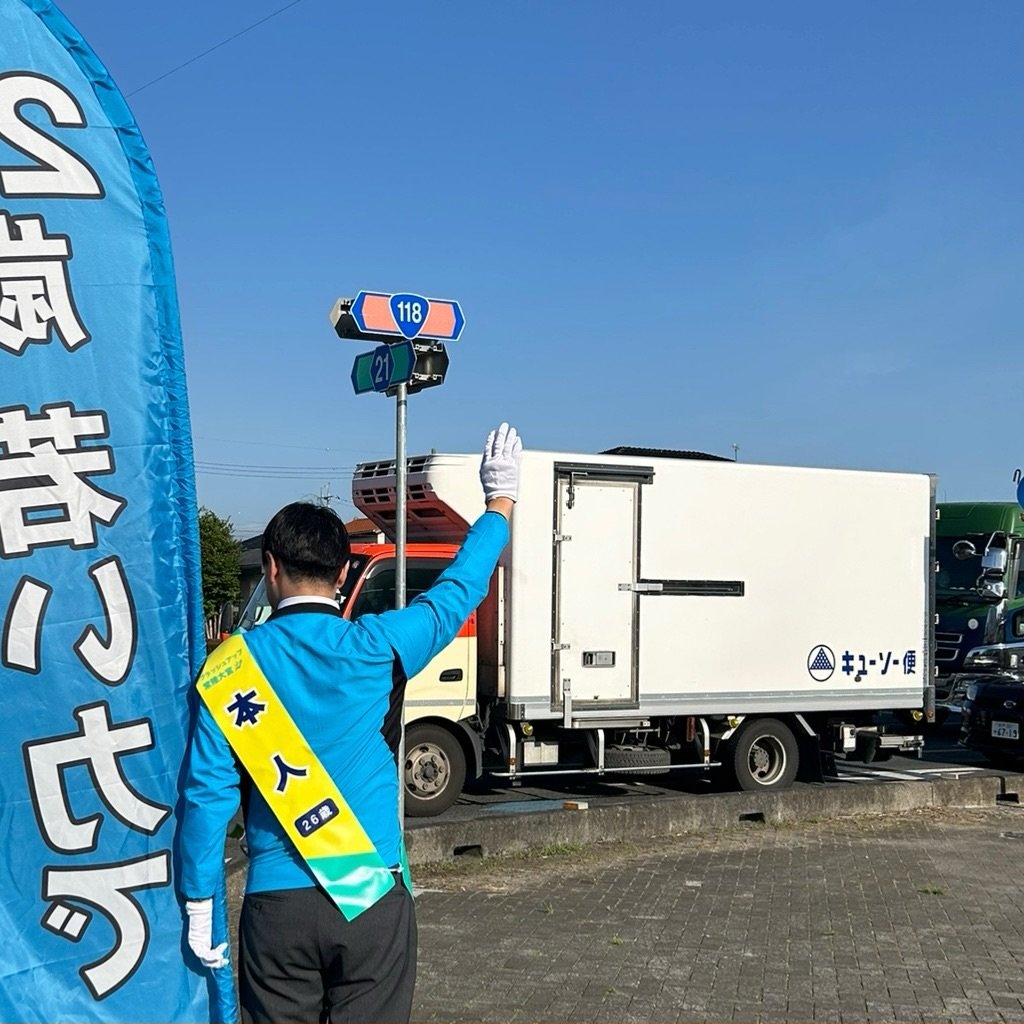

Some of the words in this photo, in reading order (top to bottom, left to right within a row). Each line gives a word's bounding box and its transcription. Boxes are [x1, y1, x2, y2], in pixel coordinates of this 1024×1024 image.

[397, 301, 422, 324] 118
[375, 353, 390, 383] 21
[842, 650, 916, 676] キューソー便
[226, 690, 308, 793] 本人
[302, 805, 333, 831] 26歳
